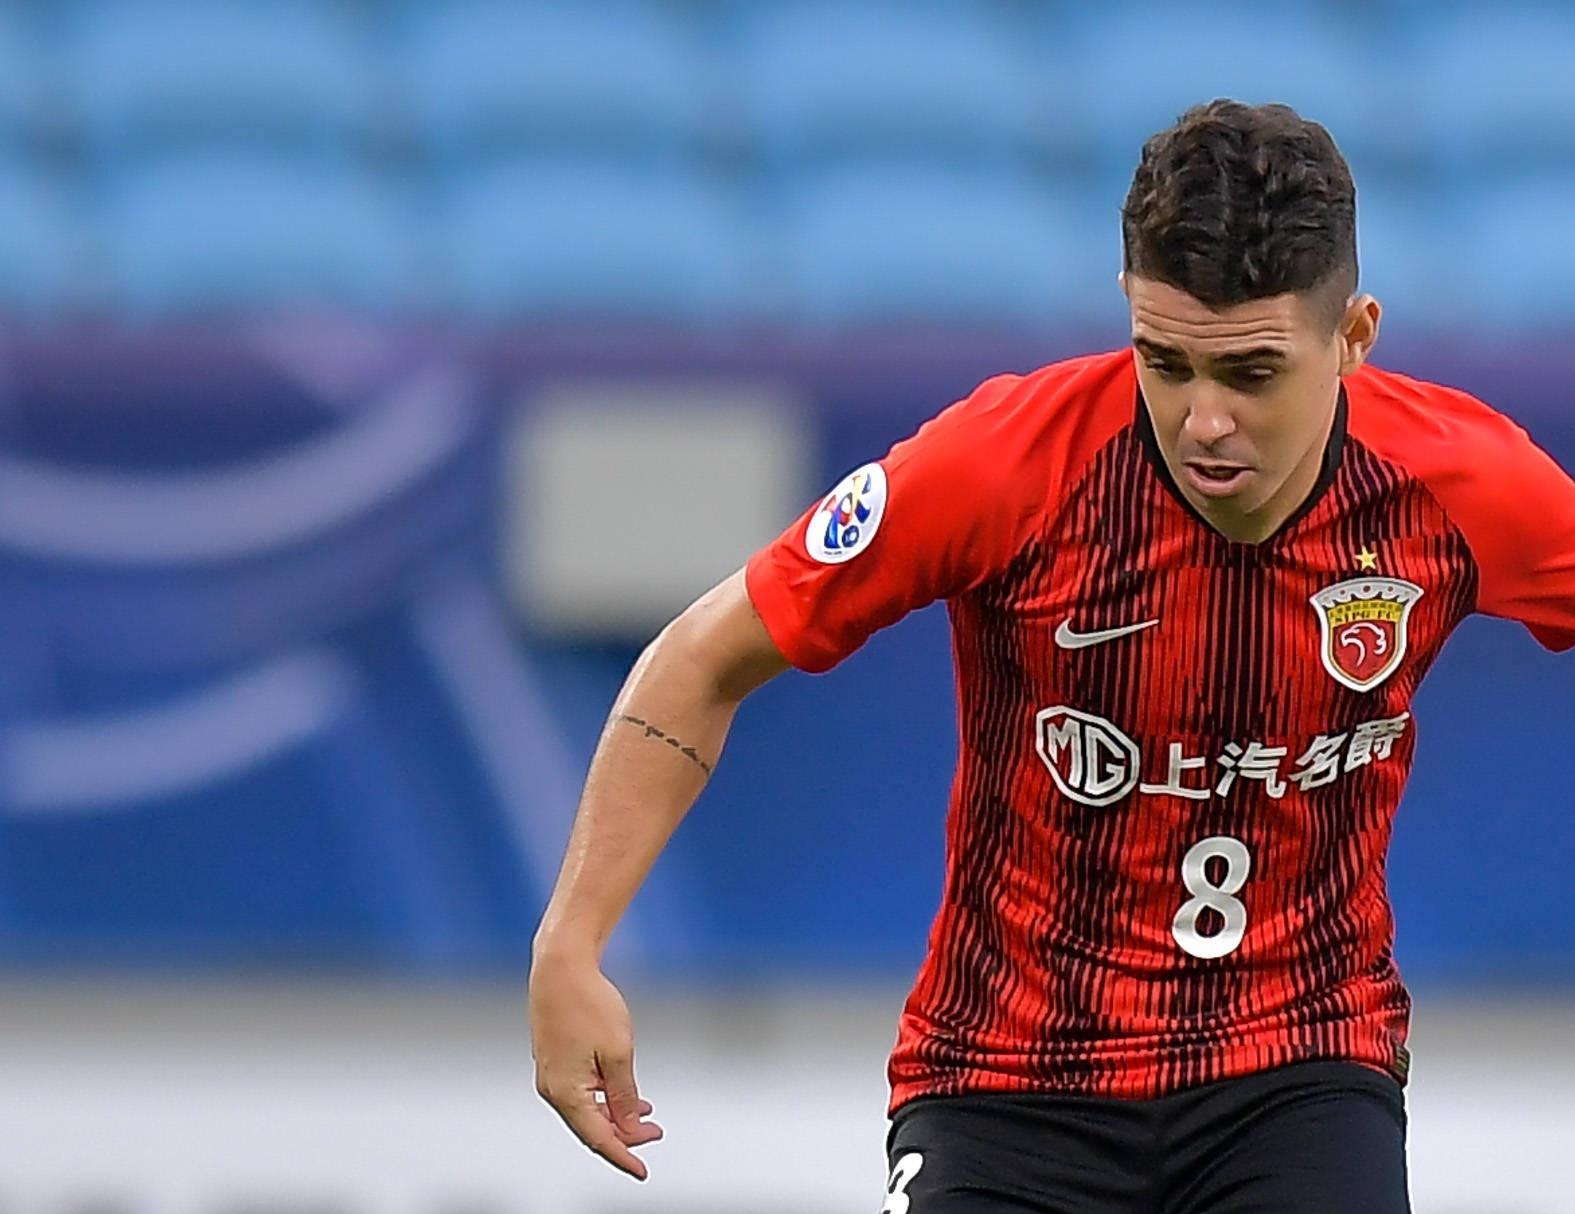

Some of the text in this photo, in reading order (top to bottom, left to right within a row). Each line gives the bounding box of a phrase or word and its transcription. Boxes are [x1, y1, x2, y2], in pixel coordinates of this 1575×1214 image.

[1045, 718, 1128, 800] MG
[1140, 712, 1410, 800] 上汽名爵
[1171, 836, 1251, 959] 8
